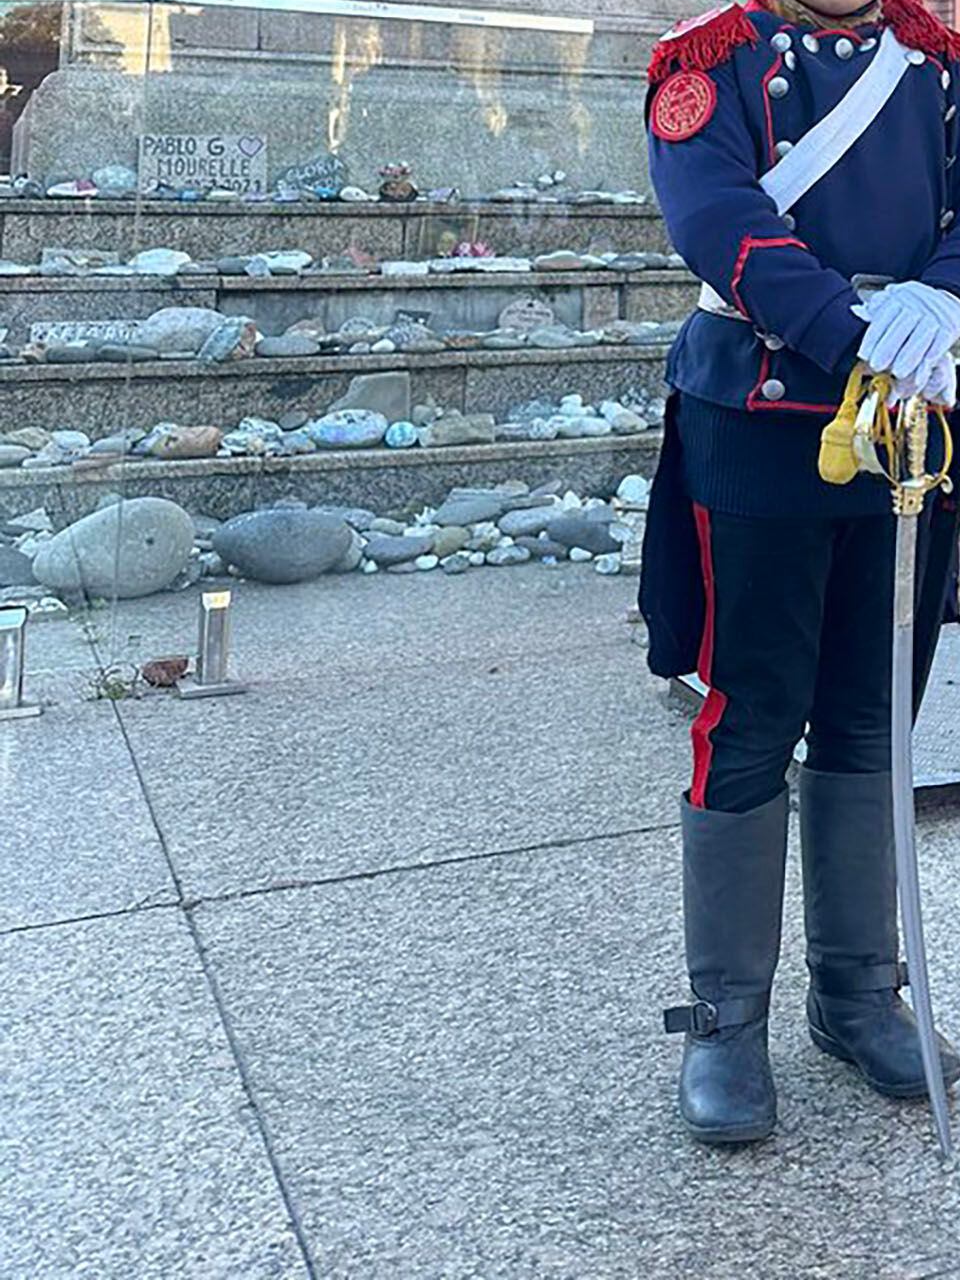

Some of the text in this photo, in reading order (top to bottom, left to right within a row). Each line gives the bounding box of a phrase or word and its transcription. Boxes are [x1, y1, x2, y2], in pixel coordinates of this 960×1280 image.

[143, 135, 225, 156] PABLO G
[158, 158, 250, 177] MOURELLE
